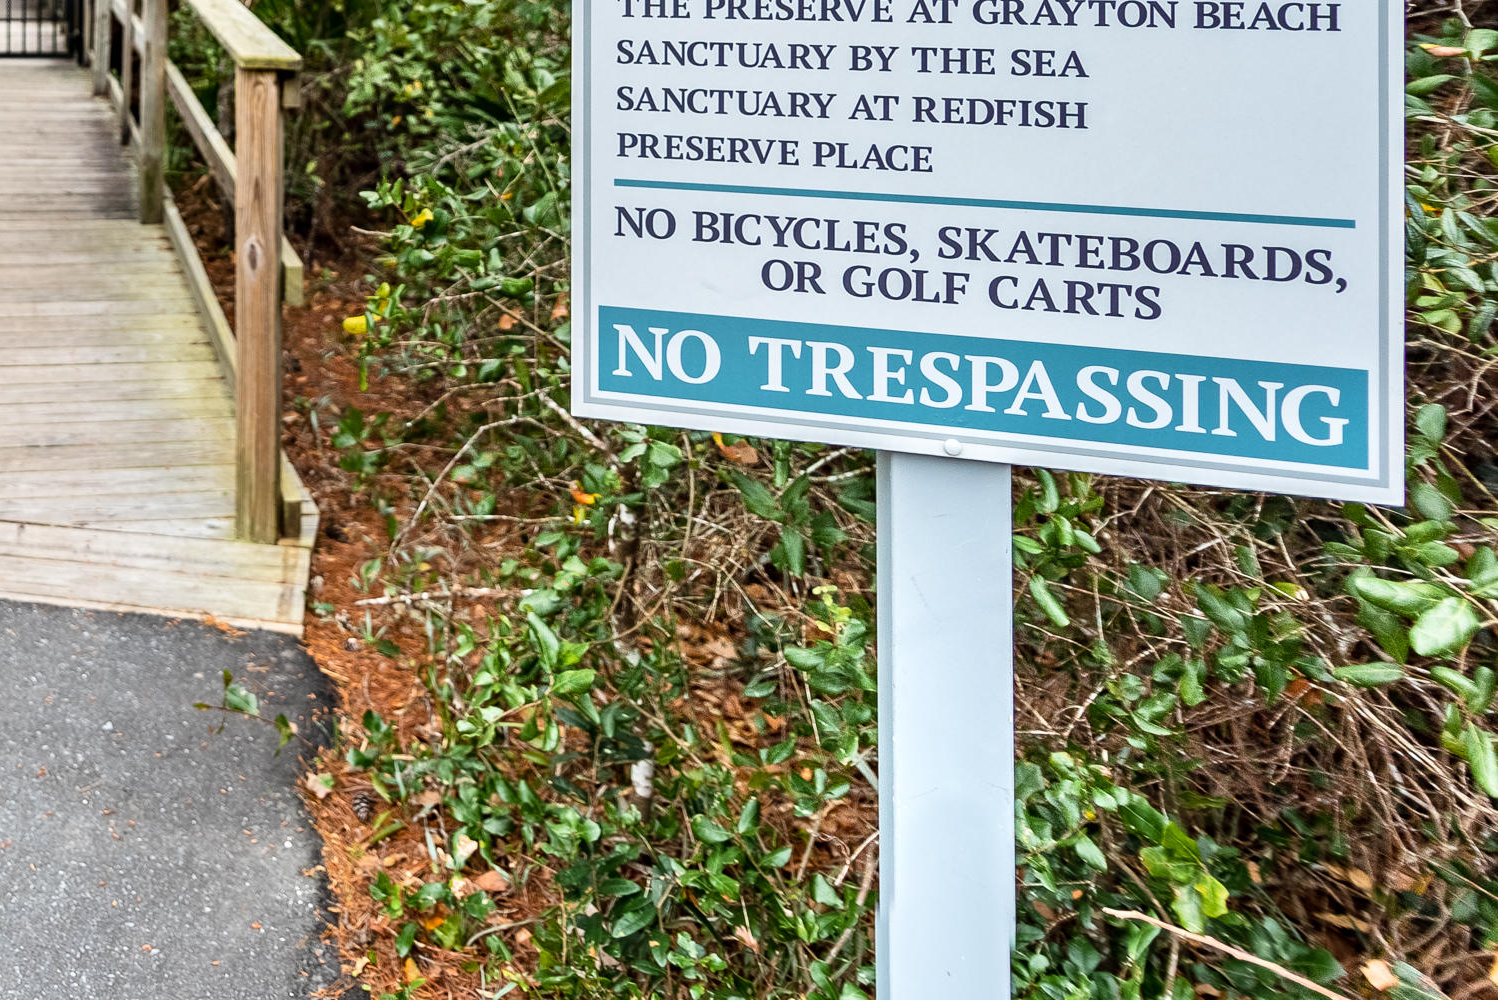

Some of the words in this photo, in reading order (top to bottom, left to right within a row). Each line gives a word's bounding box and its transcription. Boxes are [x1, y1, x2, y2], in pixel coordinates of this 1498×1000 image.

[1192, 1, 1342, 32] BEACH
[616, 39, 838, 71] SANCTUARY
[848, 45, 900, 72] BY
[911, 46, 996, 75] THE
[1010, 48, 1090, 78] SEA
[616, 85, 838, 119] SANCTUARY
[847, 94, 900, 122] AT
[911, 96, 1089, 130] REDFISH
[616, 132, 800, 166] PRESERVE
[812, 141, 934, 173] PLACE
[613, 205, 677, 240] NO
[691, 210, 920, 264] BICYCLES,
[936, 225, 1349, 294] SKATEBOARDS,
[761, 259, 827, 295] OR
[842, 264, 971, 305] GOLF
[988, 275, 1162, 321] CARTS
[612, 323, 722, 385] NO
[748, 335, 1351, 447] TRESPASSING
